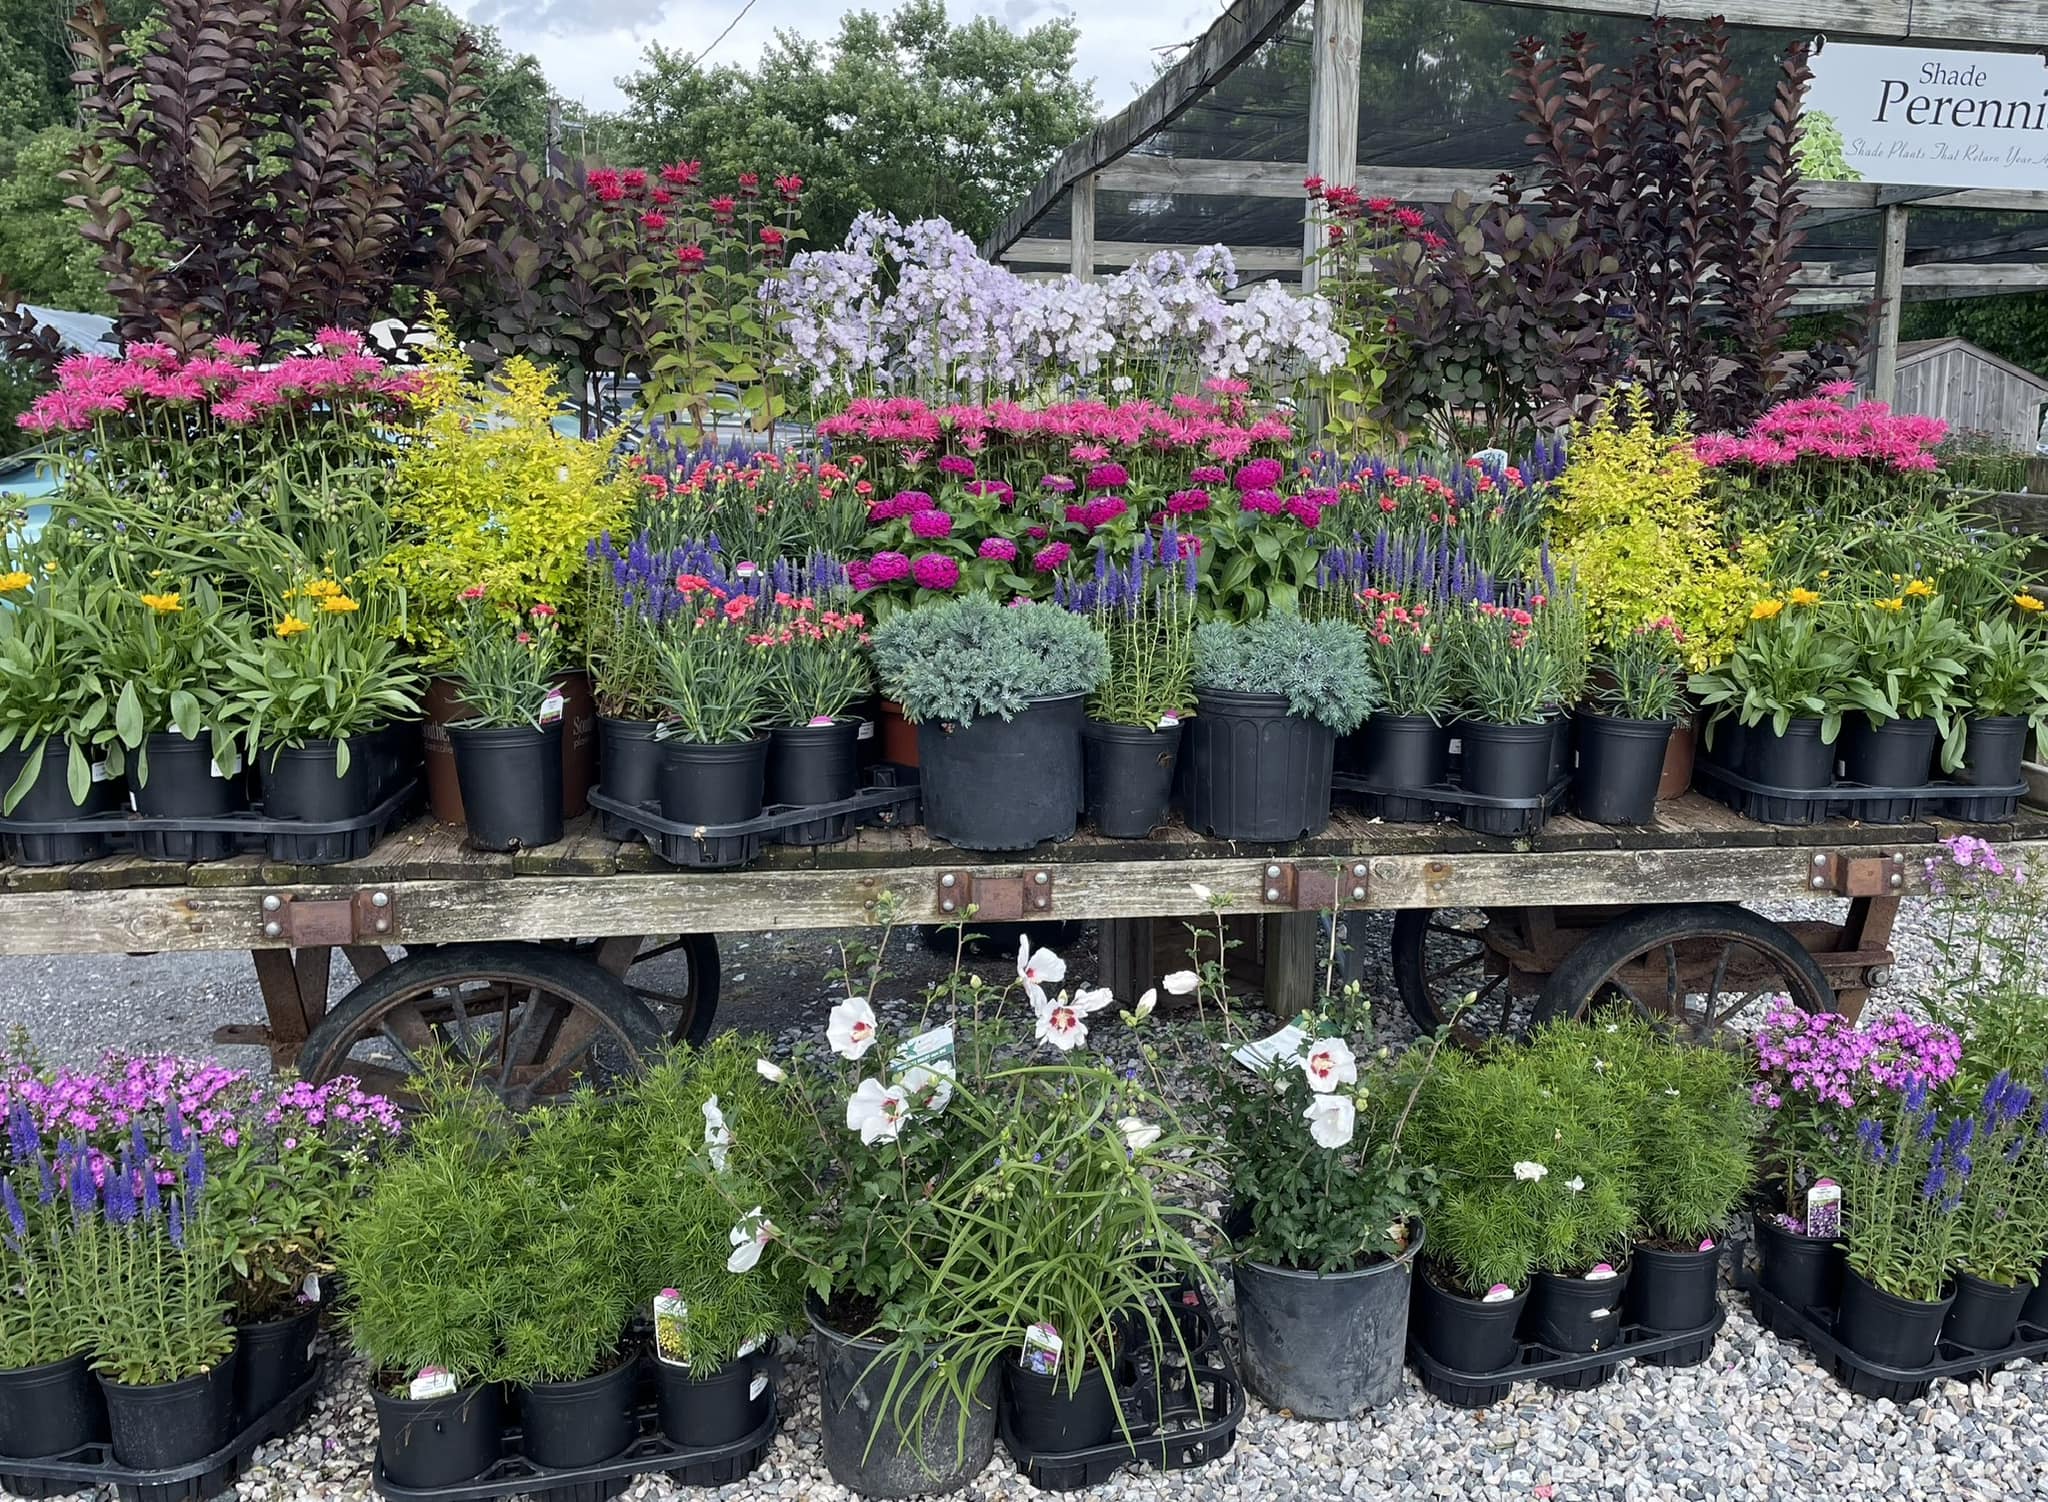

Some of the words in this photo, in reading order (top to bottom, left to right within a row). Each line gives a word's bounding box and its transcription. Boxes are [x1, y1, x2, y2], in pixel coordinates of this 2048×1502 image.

[1919, 62, 1987, 87] Shade
[1872, 79, 2048, 130] Perenni
[1845, 137, 1884, 158] Shade
[1887, 139, 1925, 159] Plants
[1930, 142, 1959, 161] That
[1962, 144, 2000, 163] Return
[2003, 145, 2032, 168] Year
